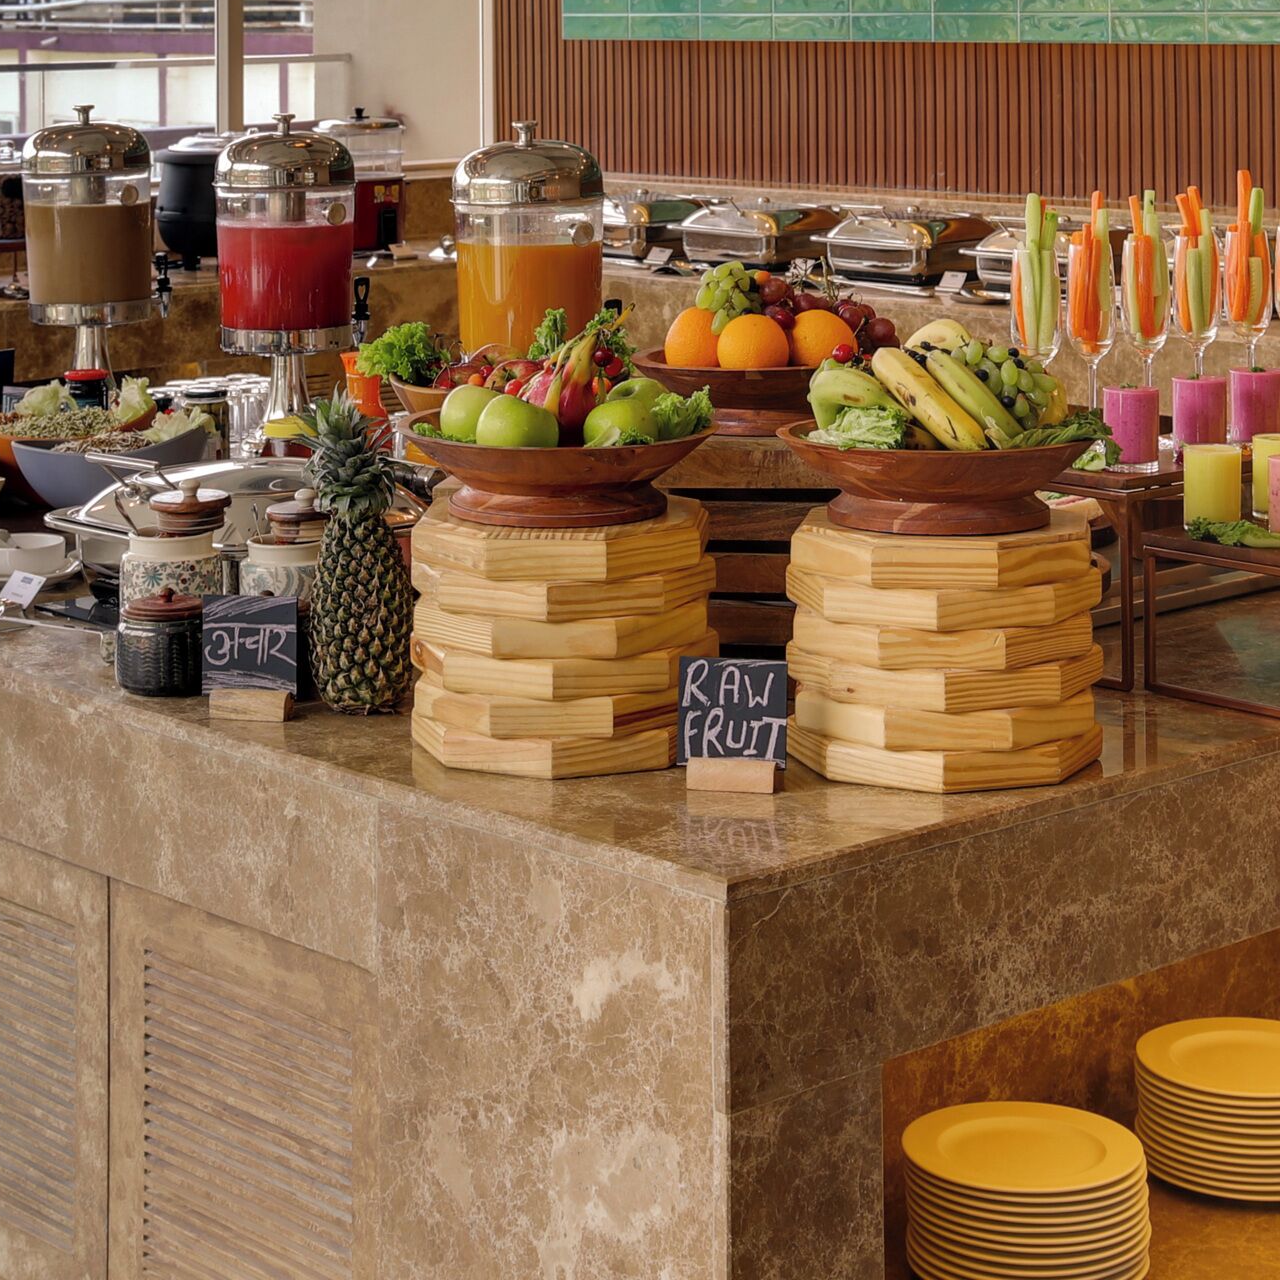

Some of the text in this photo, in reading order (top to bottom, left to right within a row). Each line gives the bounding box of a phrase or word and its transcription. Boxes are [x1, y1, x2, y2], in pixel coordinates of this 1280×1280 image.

[203, 622, 297, 667] अचार
[682, 658, 775, 708] RAW
[683, 706, 787, 761] FRUIT
